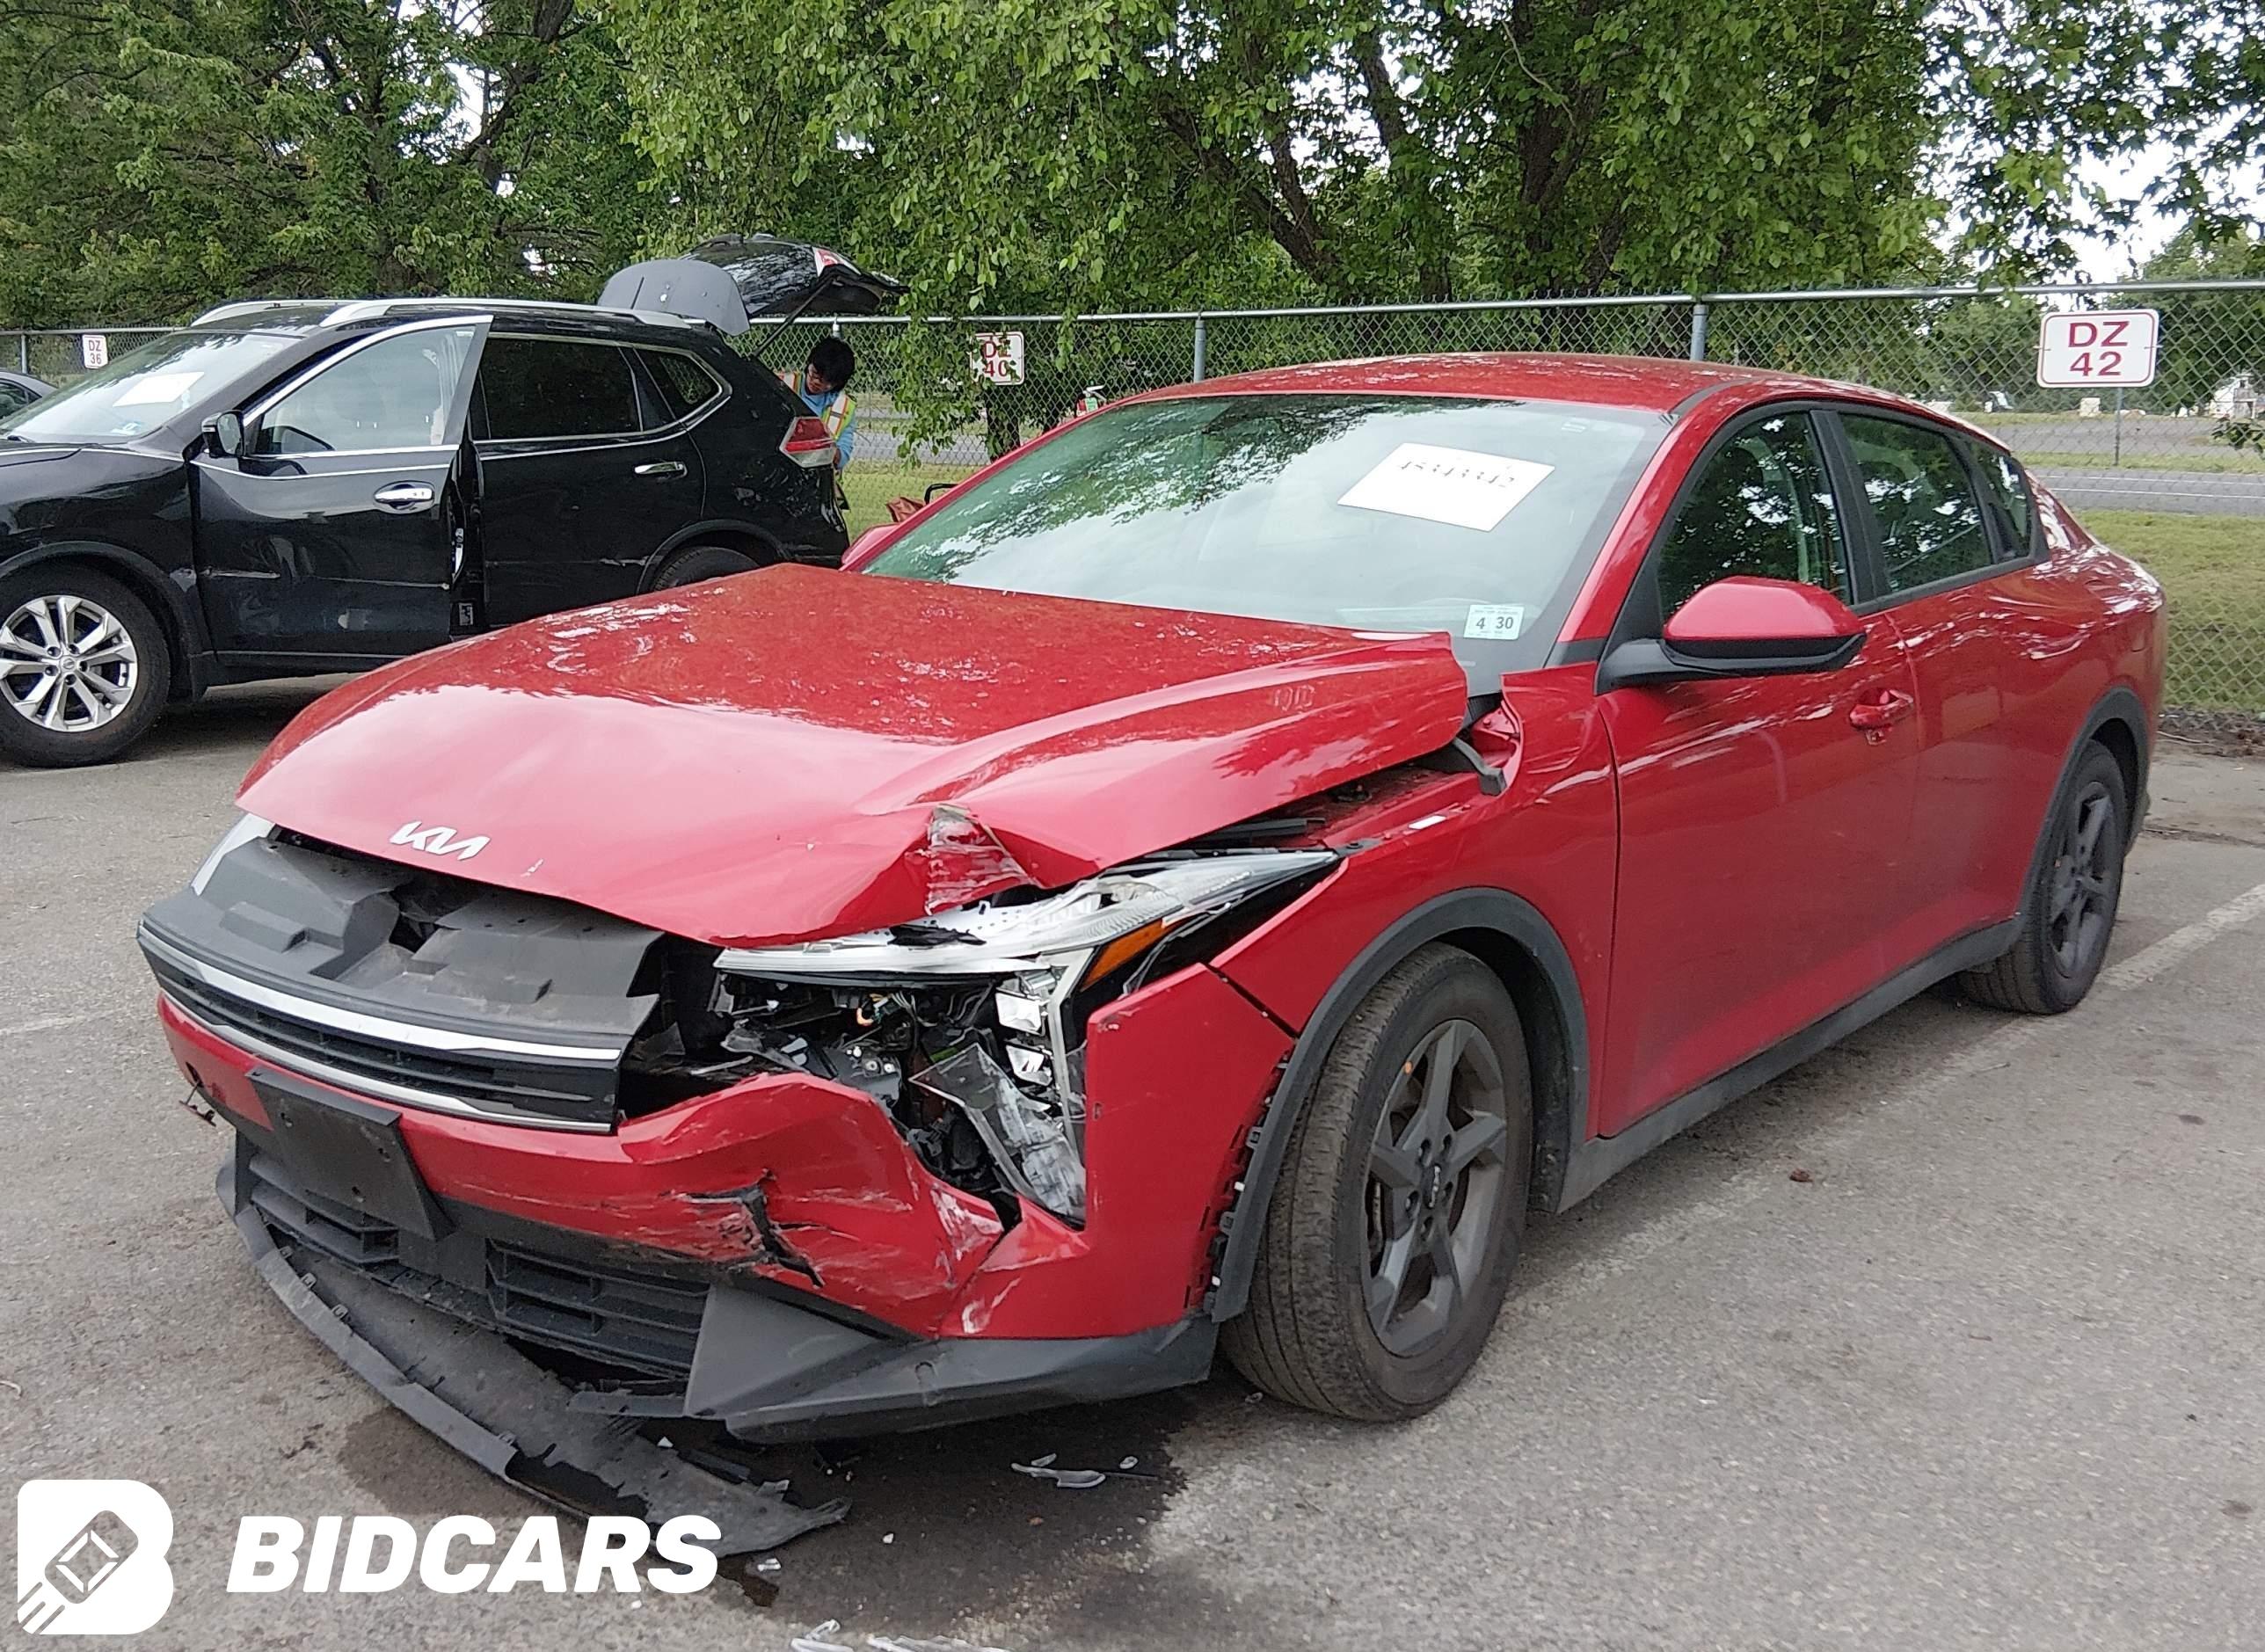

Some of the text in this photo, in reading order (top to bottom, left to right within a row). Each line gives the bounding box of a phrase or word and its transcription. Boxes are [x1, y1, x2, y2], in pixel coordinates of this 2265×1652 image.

[2068, 321, 2130, 347] DZ
[88, 339, 102, 352] DZ
[90, 353, 102, 365] 36
[2069, 351, 2123, 377] 42
[982, 360, 1010, 377] 40
[1475, 616, 1514, 630] 4 30
[389, 819, 492, 862] KIA
